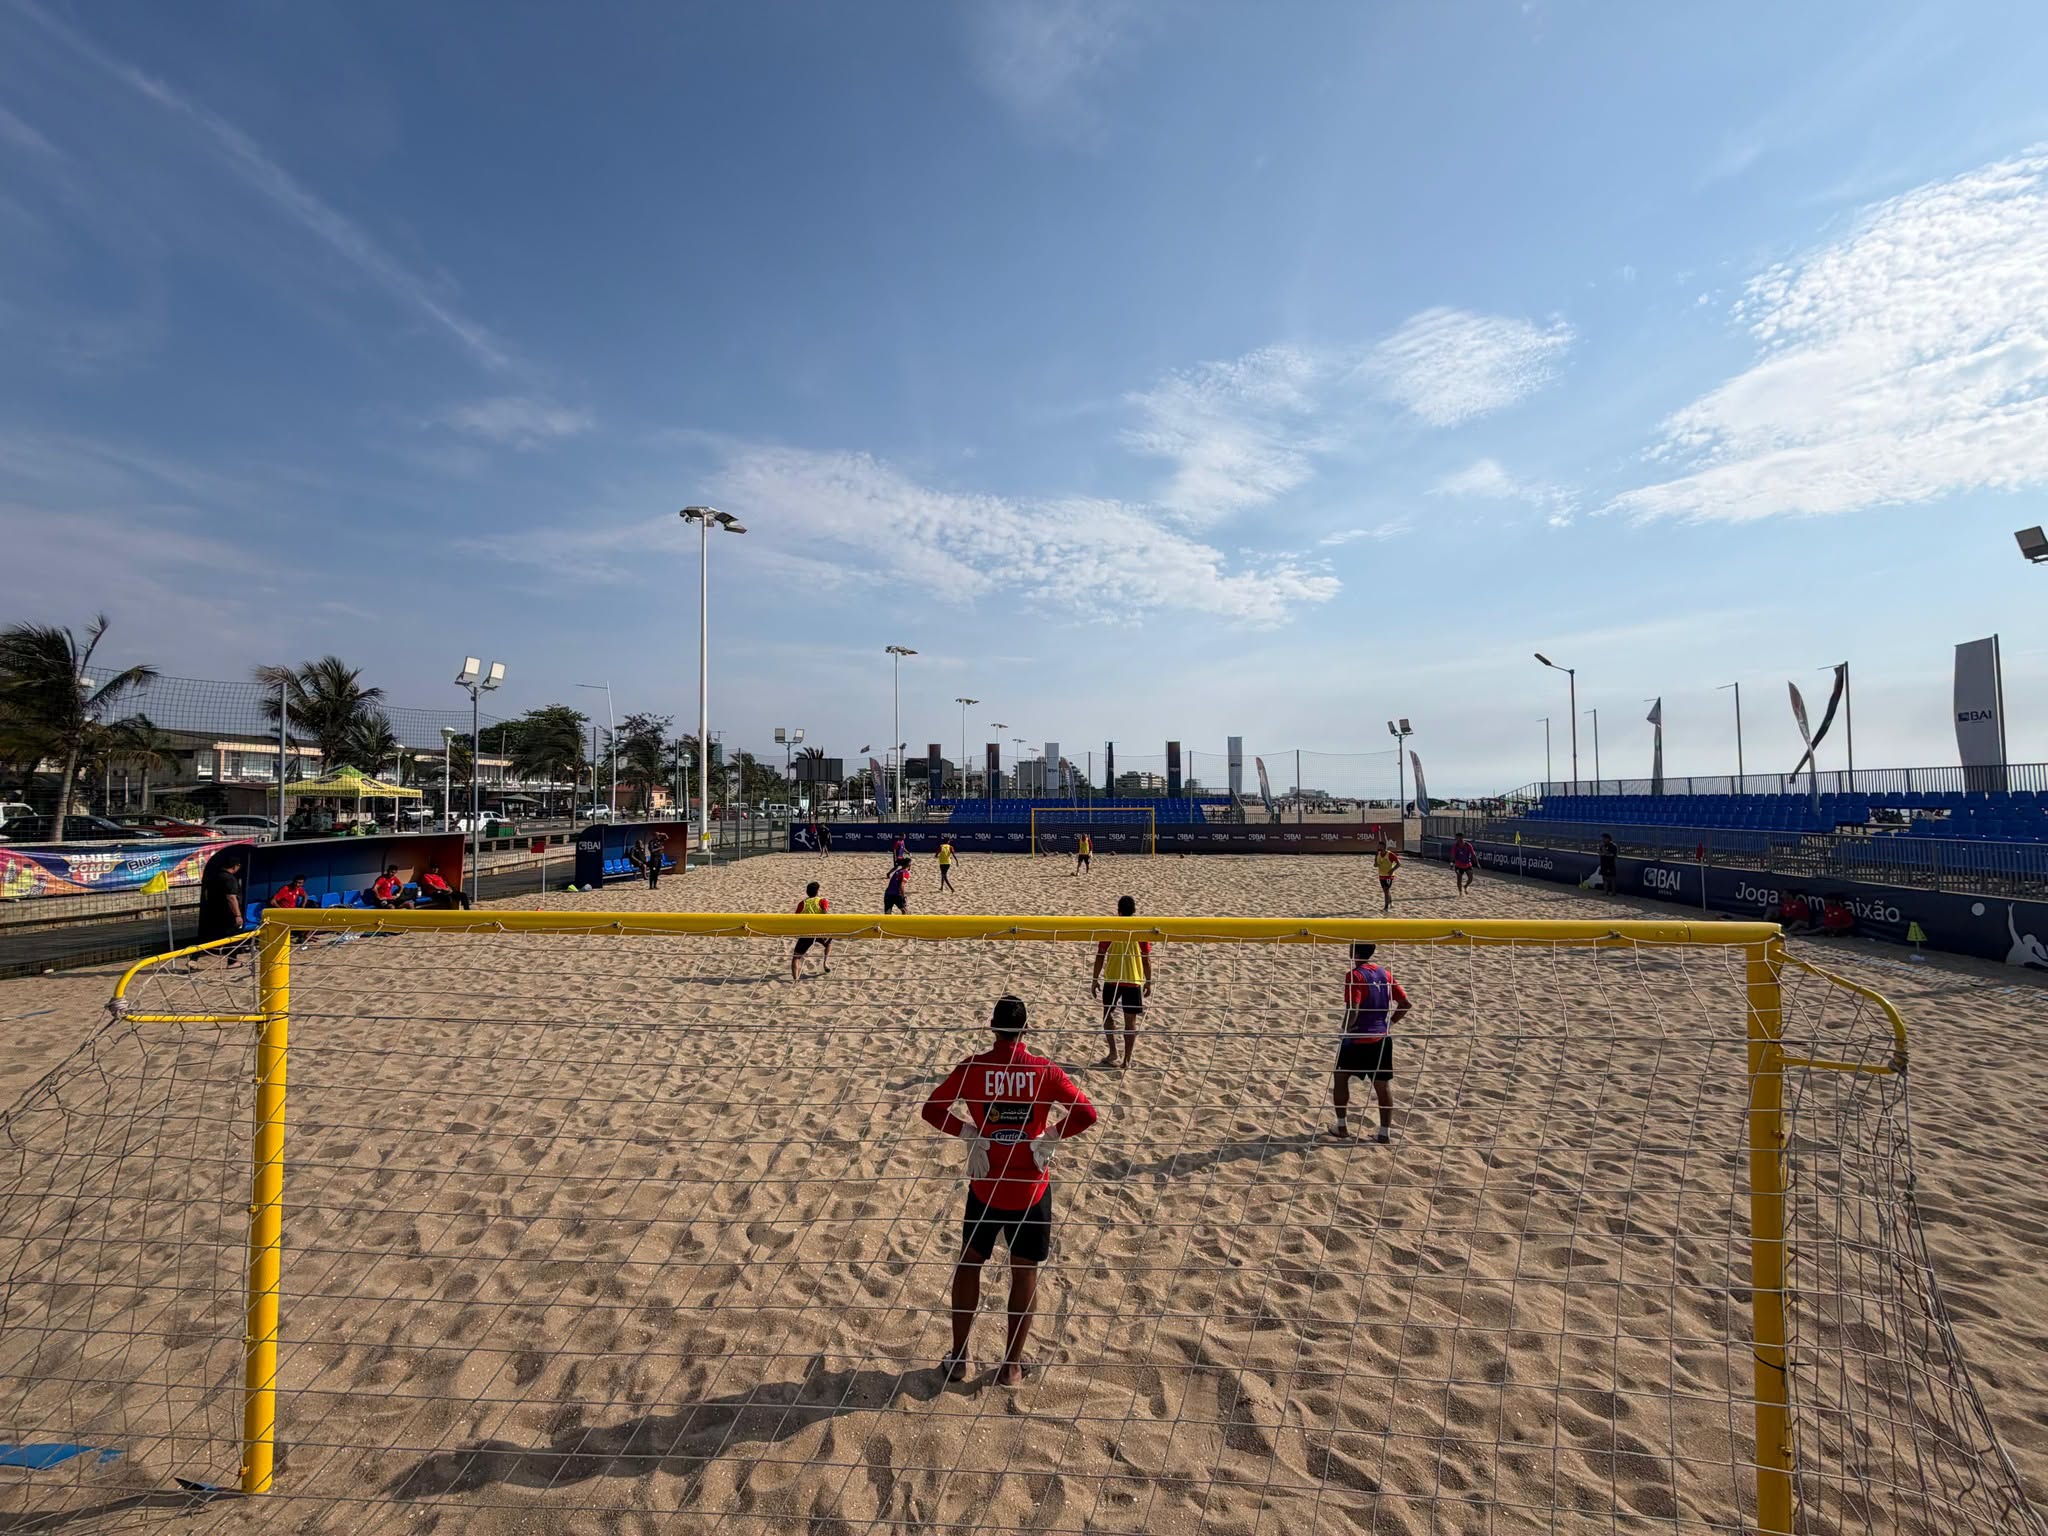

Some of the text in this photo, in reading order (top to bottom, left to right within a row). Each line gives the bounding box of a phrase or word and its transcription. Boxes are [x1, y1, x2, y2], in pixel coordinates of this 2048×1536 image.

[1970, 710, 1992, 720] BAI
[68, 863, 111, 872] COMO
[127, 853, 161, 872] Blue
[1511, 855, 1527, 866] uma
[1528, 856, 1553, 870] paixão
[80, 872, 100, 881] TU
[1657, 869, 1680, 890] BAI
[1735, 881, 1779, 906] Joga
[1840, 896, 1900, 922] aixão
[985, 1071, 1036, 1097] EGYPT
